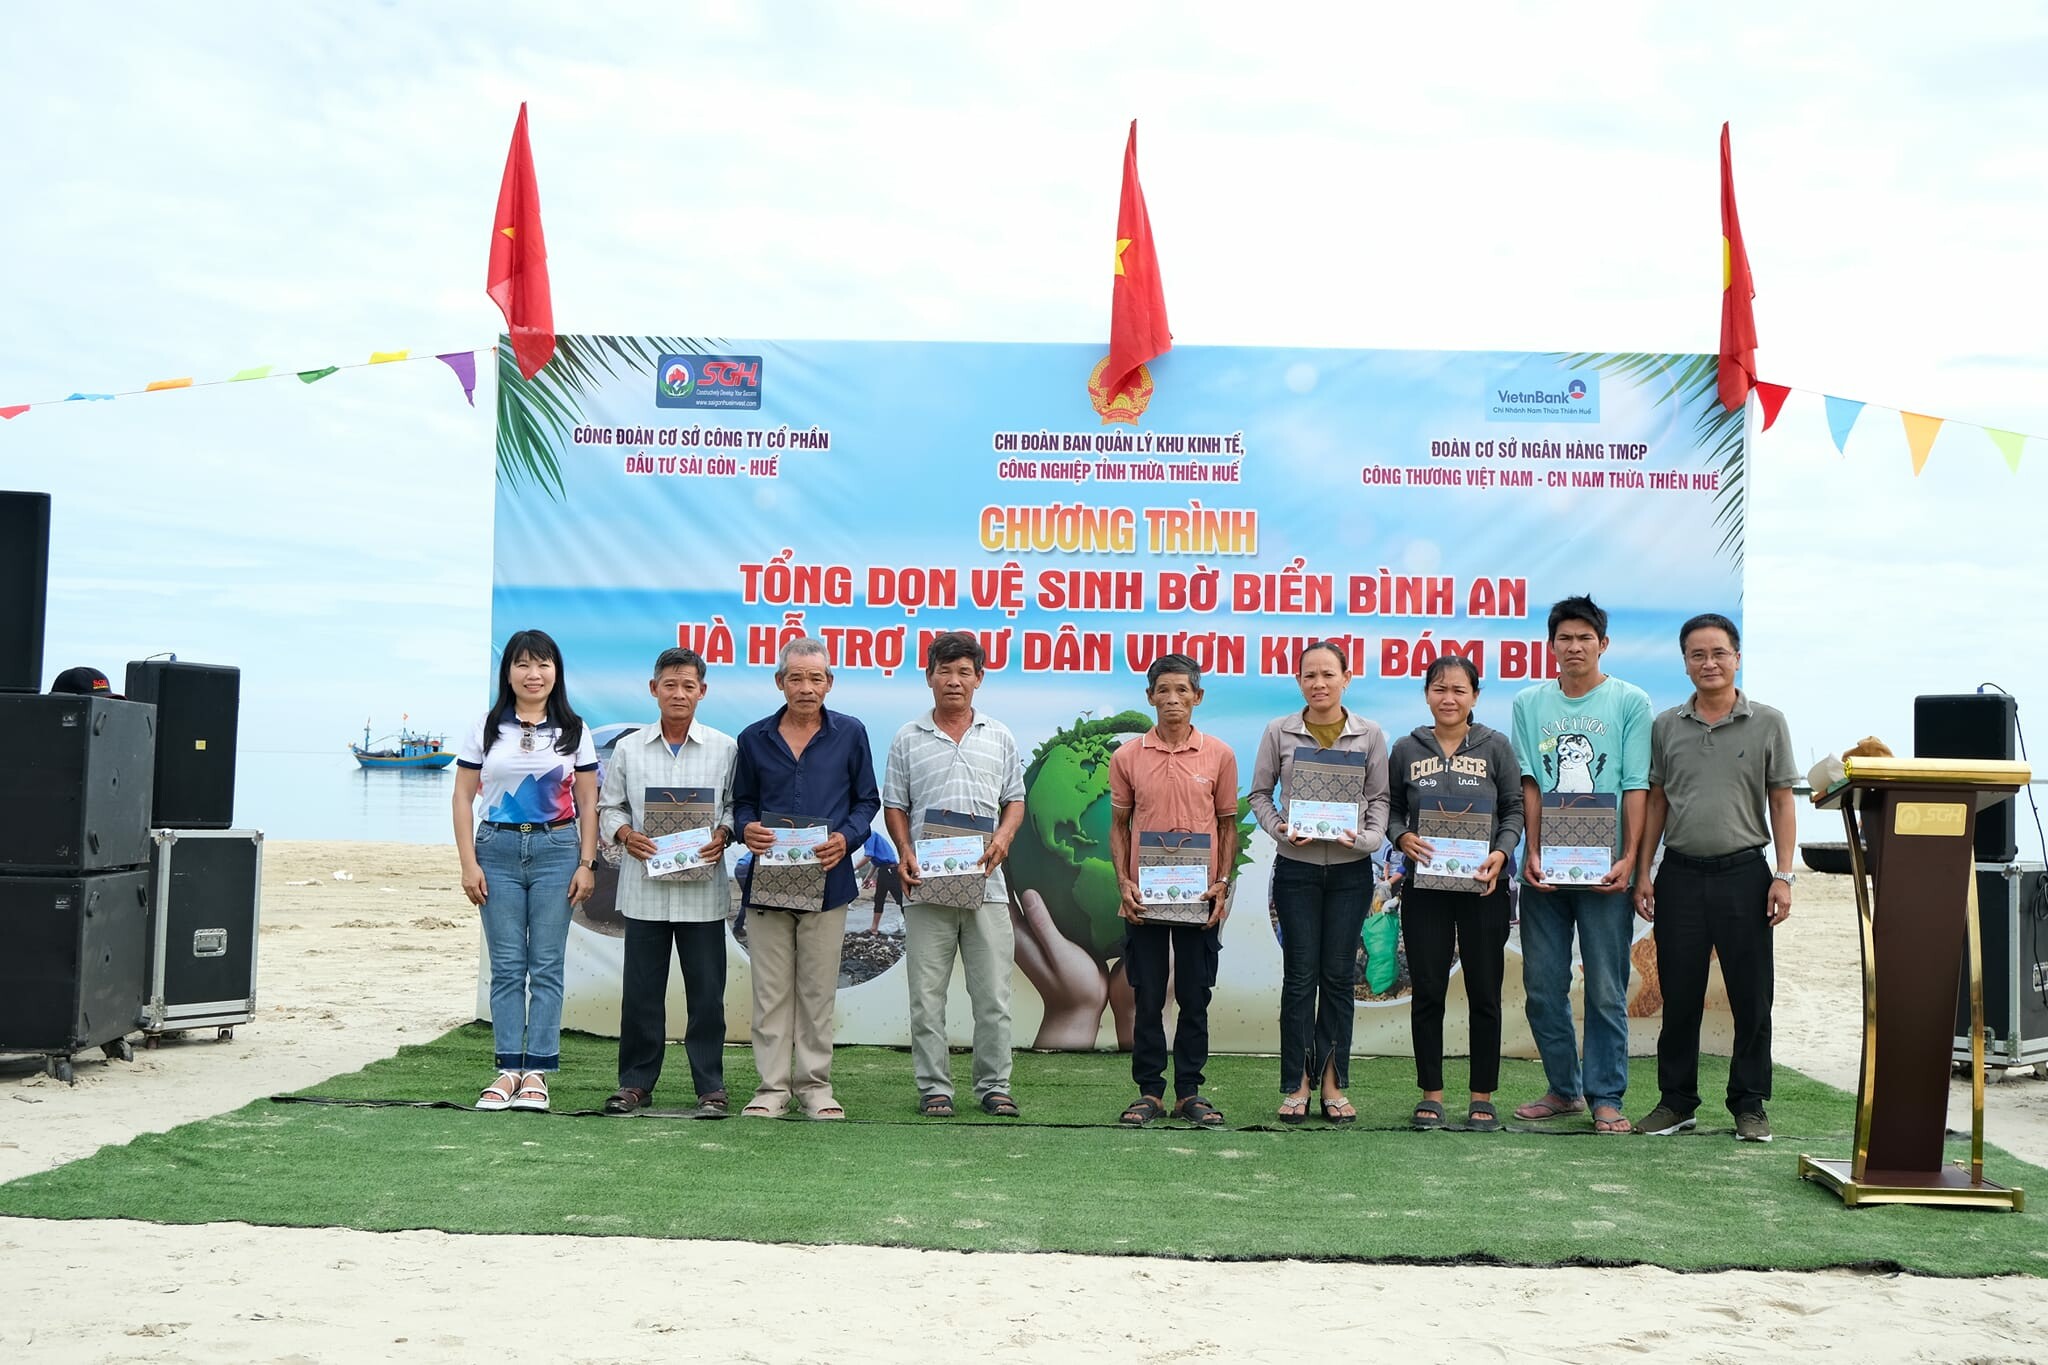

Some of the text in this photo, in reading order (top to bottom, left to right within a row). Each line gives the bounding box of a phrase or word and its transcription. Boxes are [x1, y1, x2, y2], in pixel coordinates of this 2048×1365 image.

[697, 362, 758, 386] SGH
[1498, 390, 1569, 404] VietinBank
[1492, 406, 1504, 414] Chi
[574, 424, 829, 449] CÔNG ĐOÀN CƠ SỞ CÔNG TY CỔ PHẦN
[995, 431, 1244, 455] CHI ĐOÀN BAN QUẢN LÝ KHU KINH TẾ,
[1432, 437, 1647, 460] ĐOÀN CƠ SỞ NGÂN HÀNG TMCP
[626, 453, 653, 473] ĐẦU
[658, 456, 676, 474] TƯ
[679, 454, 702, 475] SÀI
[707, 455, 735, 475] GÒN
[749, 455, 777, 476] HUẾ
[999, 458, 1240, 483] CÔNG NGHIỆP TỈNH THỪA THIÊN HUẾ
[1363, 465, 1401, 484] CÔNG
[1406, 467, 1461, 486] THƯƠNG
[1466, 467, 1496, 489] VIỆT
[1500, 470, 1533, 486] NAM
[1547, 471, 1567, 487] CN
[1572, 471, 1604, 488] NAM
[1609, 469, 1645, 488] THỪA
[1649, 470, 1688, 490] THIÊN
[1693, 469, 1720, 490] HUẾ
[980, 501, 1256, 553] CHƯƠNG TRÌNH
[739, 549, 1527, 616] TỔNG DỌN VỆ SINH BỜ BIỂN BÌNH AN
[678, 618, 734, 663] VÀ
[820, 626, 904, 675] TRỢ
[919, 628, 1012, 669] NƯ
[1023, 625, 1112, 671] DÂN
[1381, 631, 1484, 677] BÁM
[1500, 641, 1561, 679] BI
